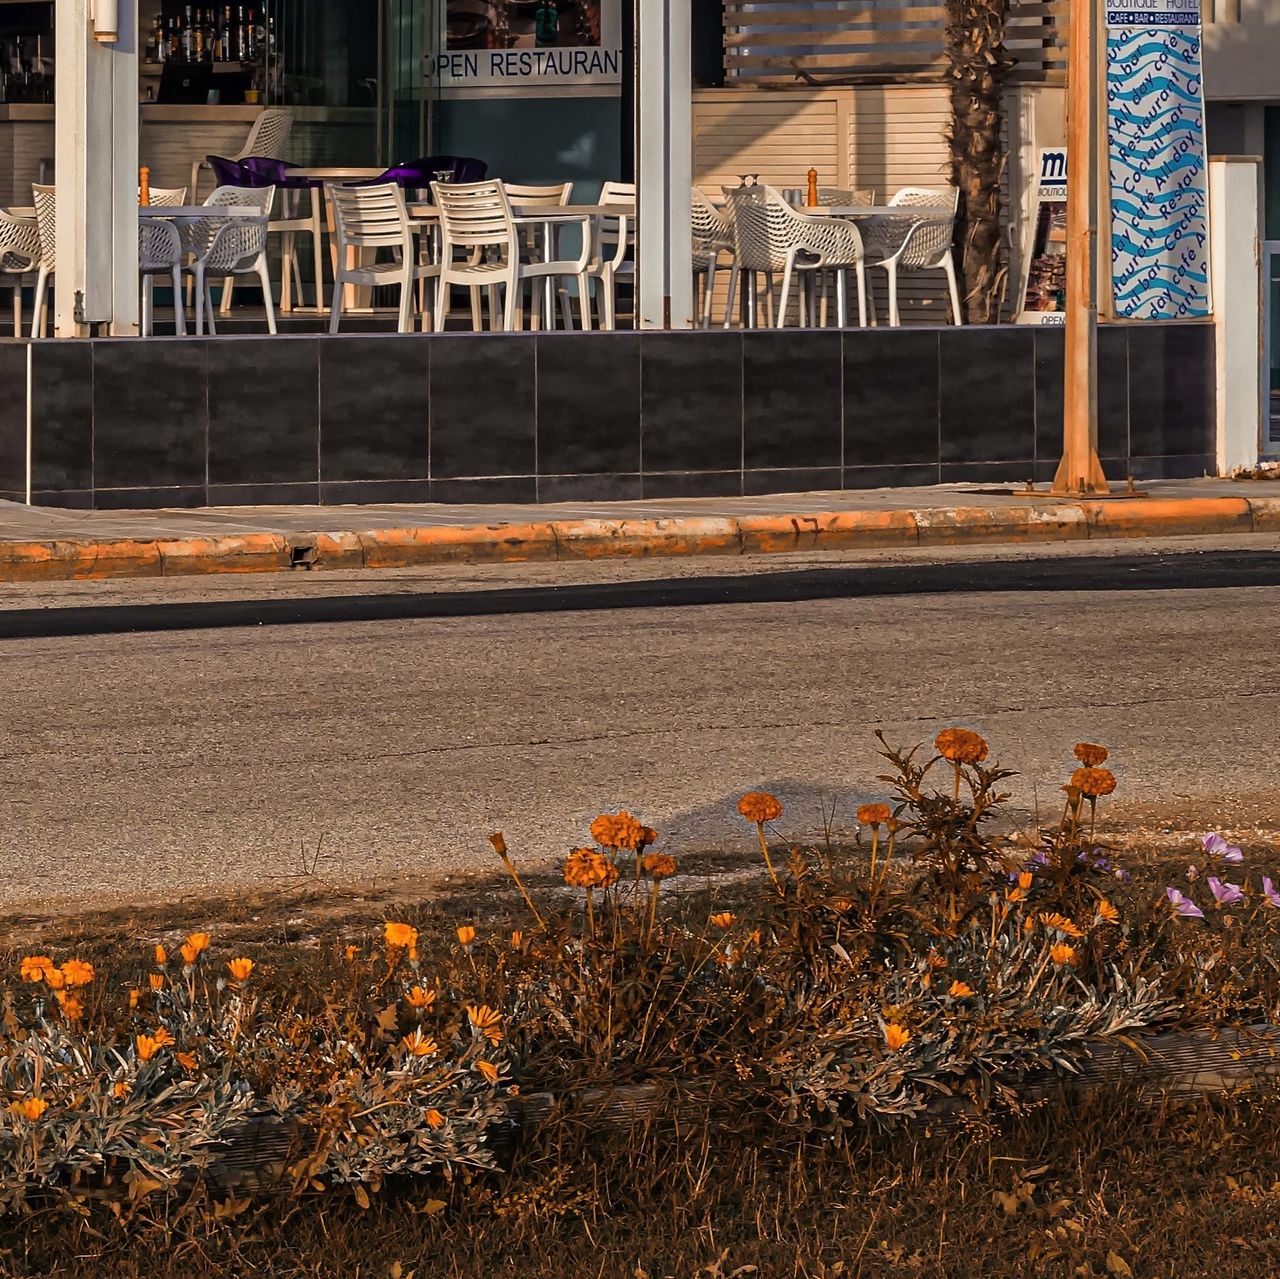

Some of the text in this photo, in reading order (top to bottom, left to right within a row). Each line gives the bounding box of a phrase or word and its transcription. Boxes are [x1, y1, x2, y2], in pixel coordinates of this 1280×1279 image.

[1108, 12, 1198, 24] CAFE BAR RESTAURANT
[491, 50, 622, 77] RESTAURAN
